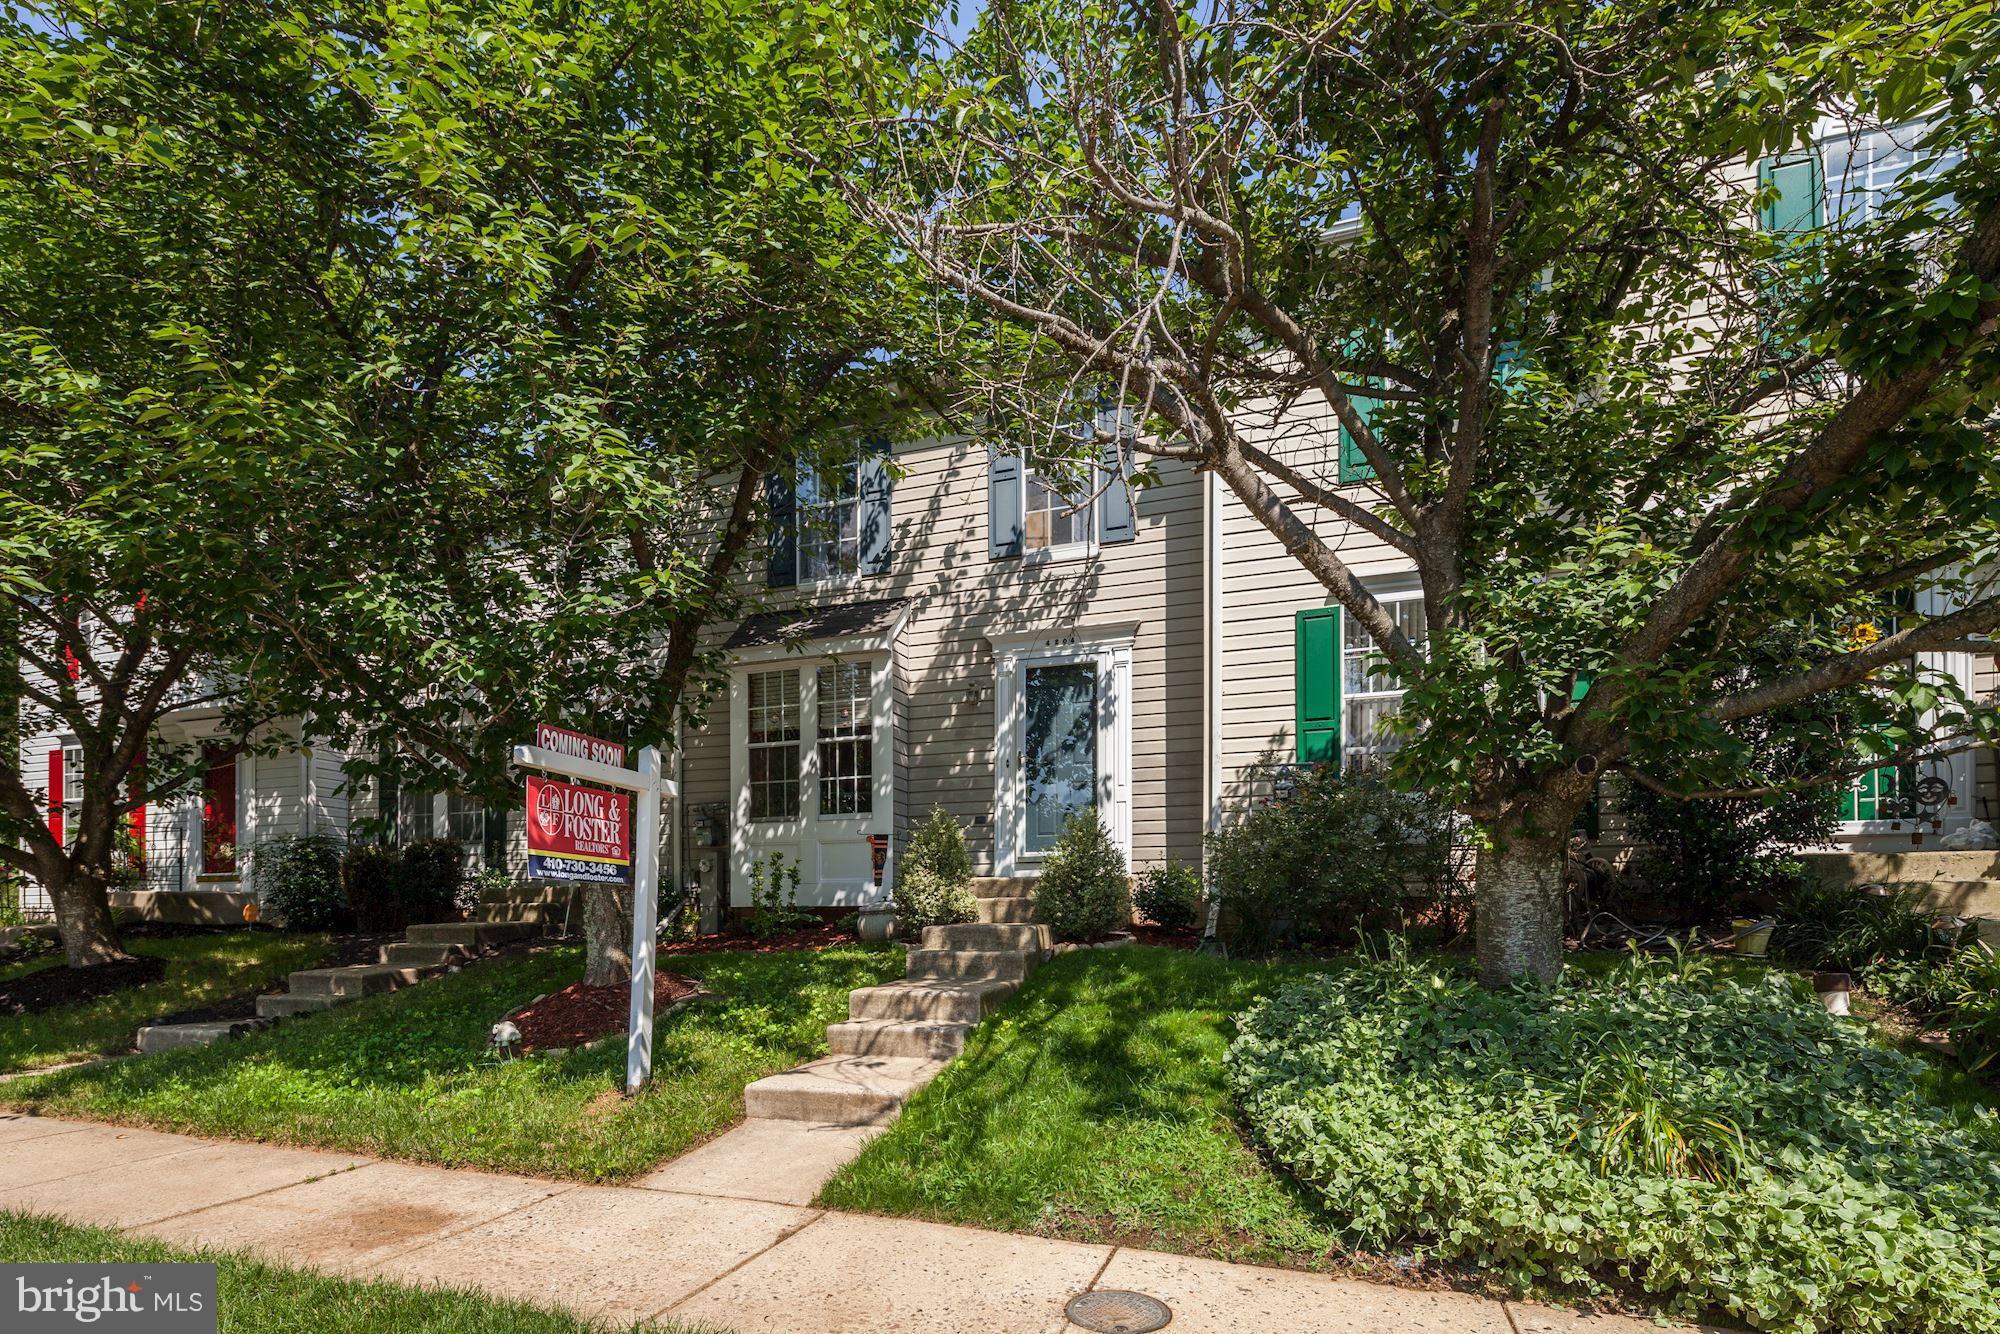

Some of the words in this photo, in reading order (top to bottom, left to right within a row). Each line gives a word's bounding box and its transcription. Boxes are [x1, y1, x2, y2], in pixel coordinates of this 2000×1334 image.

[541, 728, 589, 760] COMING
[591, 742, 622, 768] SOON
[564, 789, 604, 819] LONG
[608, 798, 621, 822] &
[564, 814, 621, 845] FOSTER
[536, 869, 624, 884] www.longandfoster.com
[543, 857, 618, 876] 410-730-3456
